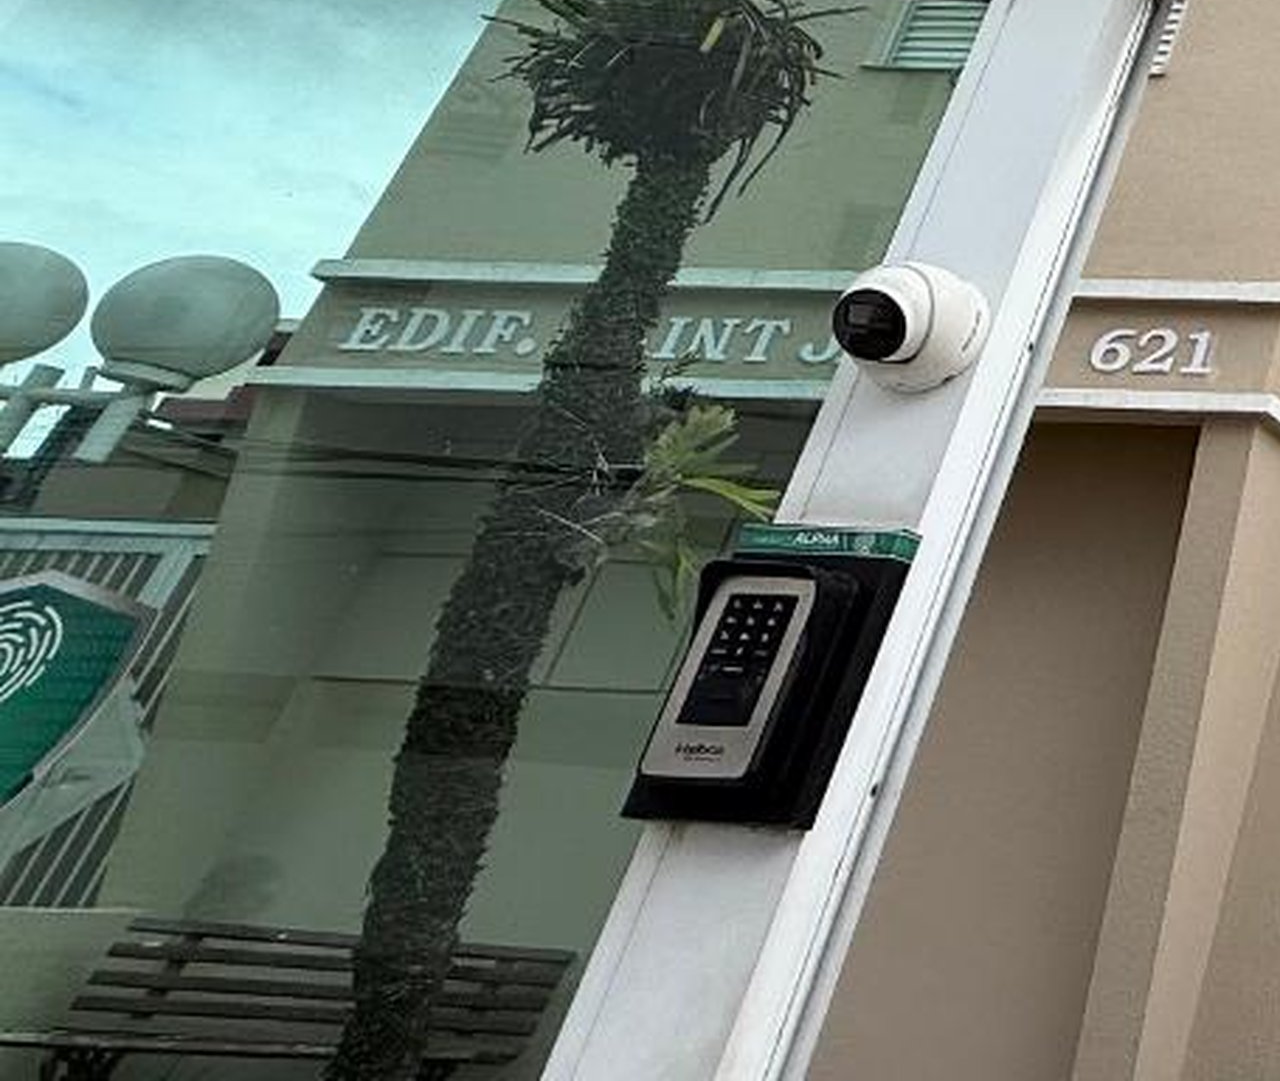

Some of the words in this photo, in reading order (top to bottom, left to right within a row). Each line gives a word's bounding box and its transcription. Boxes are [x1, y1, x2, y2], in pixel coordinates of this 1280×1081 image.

[338, 307, 537, 355] EDIF.
[649, 316, 791, 363] INT
[1090, 328, 1212, 373] 621
